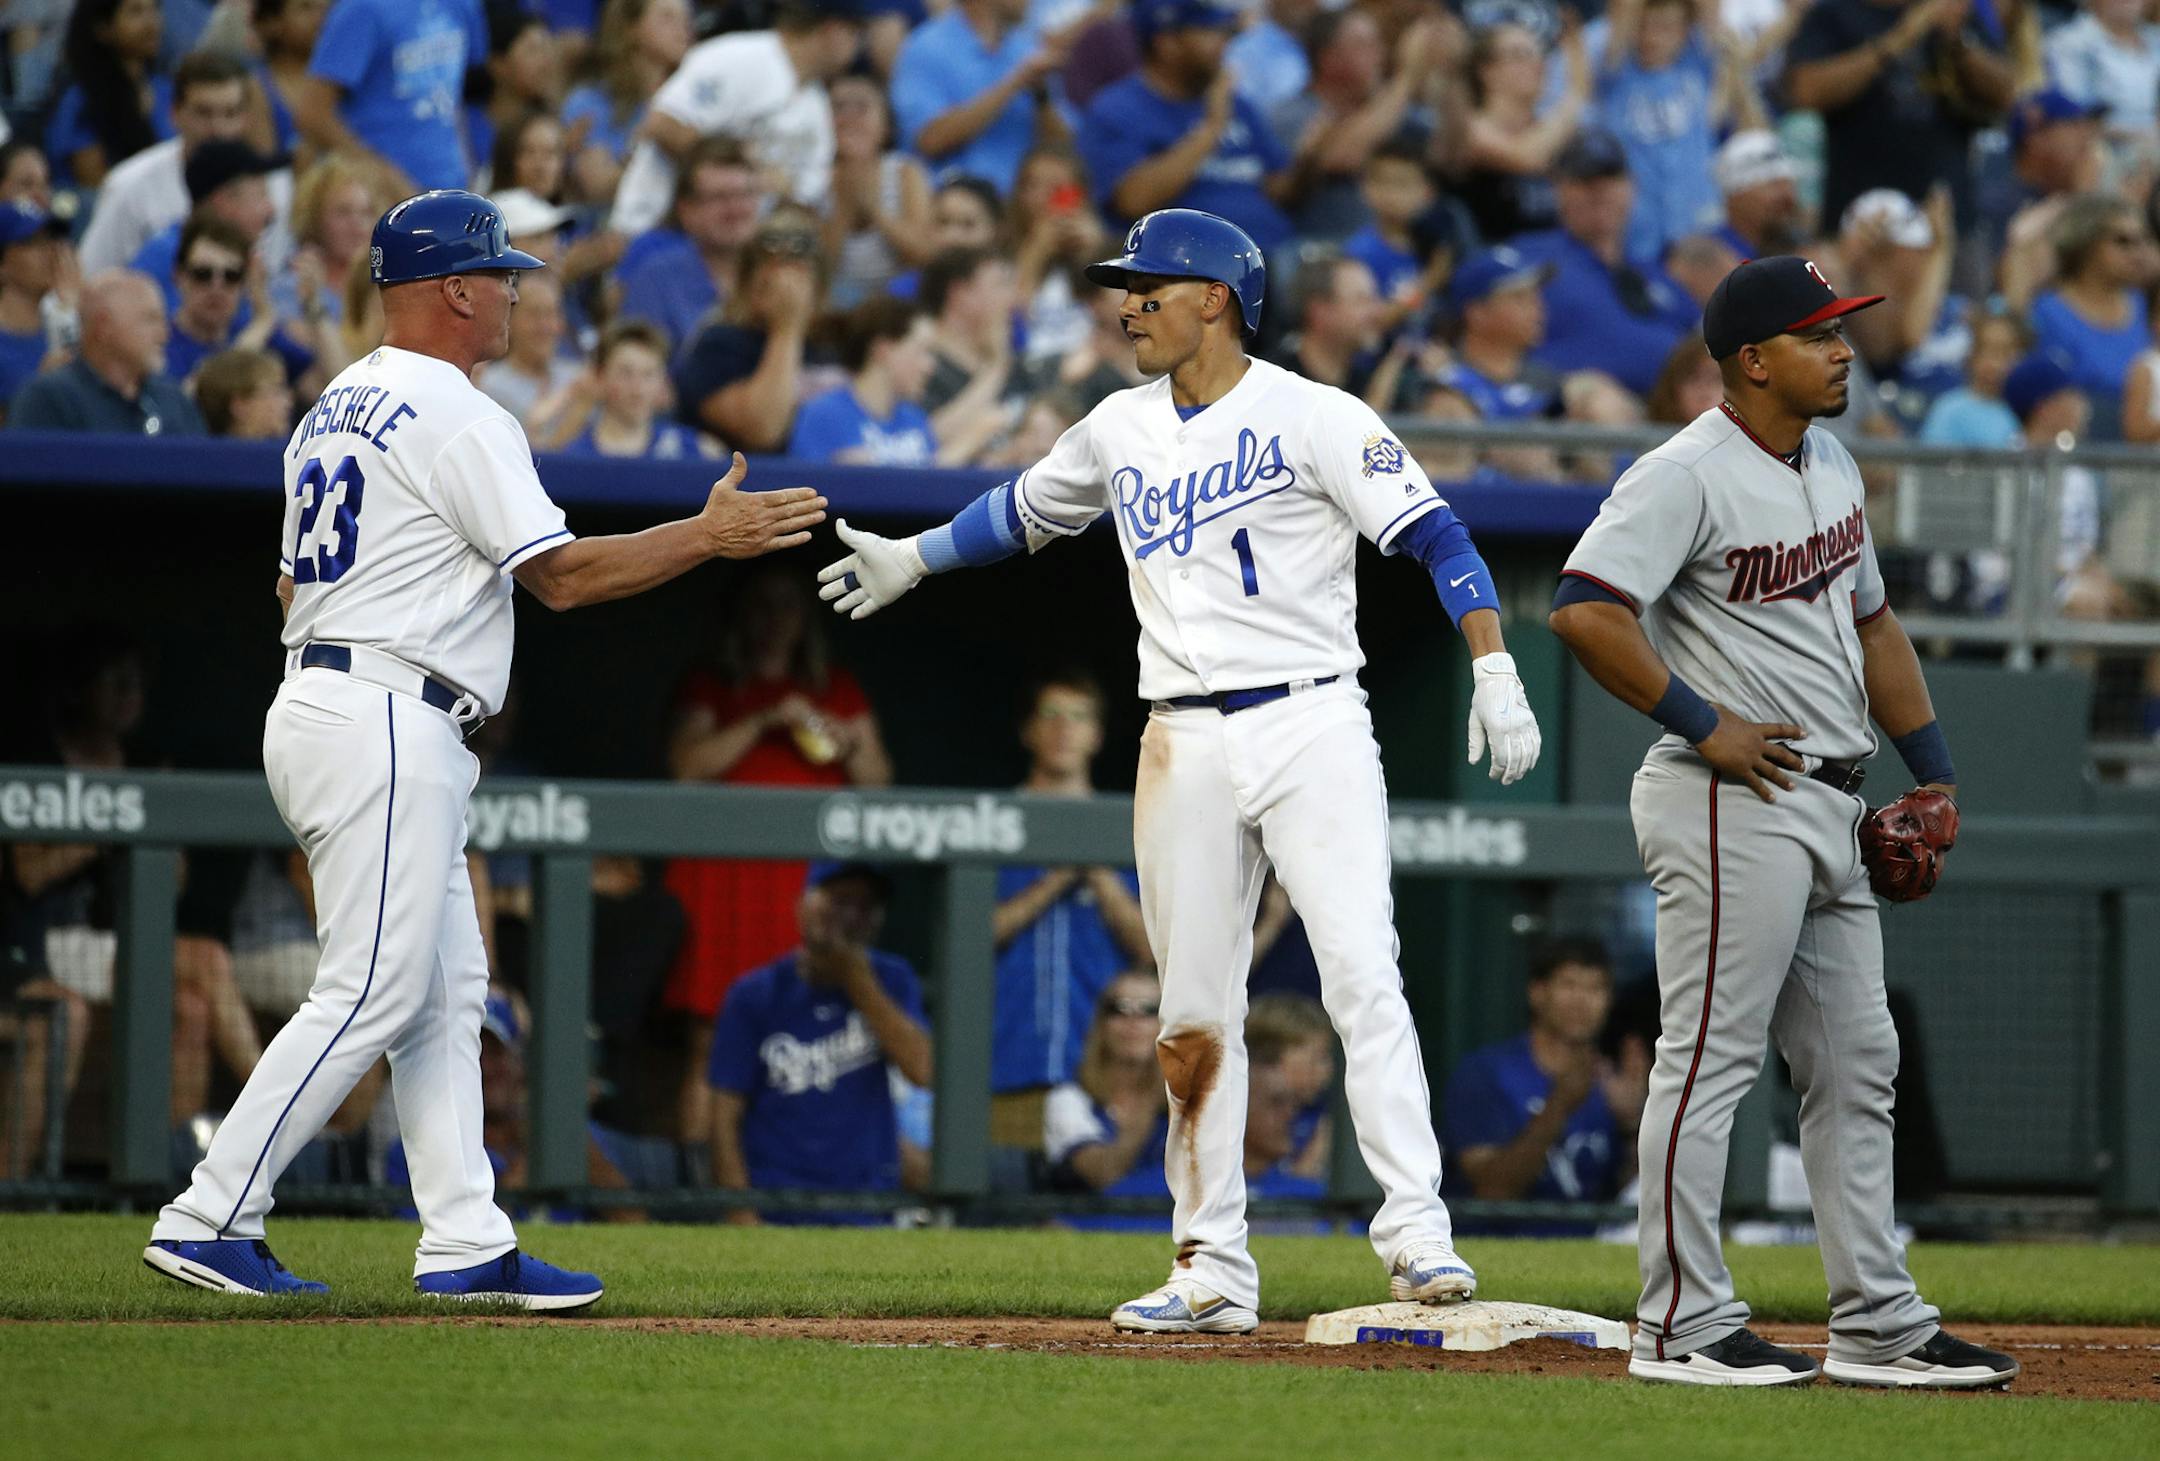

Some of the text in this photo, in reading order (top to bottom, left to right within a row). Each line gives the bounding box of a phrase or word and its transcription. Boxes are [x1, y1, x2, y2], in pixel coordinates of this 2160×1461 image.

[1367, 441, 1399, 469] 50
[294, 455, 365, 585] 23
[1112, 427, 1295, 560] Royals
[1230, 527, 1260, 597] 1
[1468, 583, 1480, 598] 1
[0, 771, 146, 833] eales
[817, 792, 1027, 861] @royals
